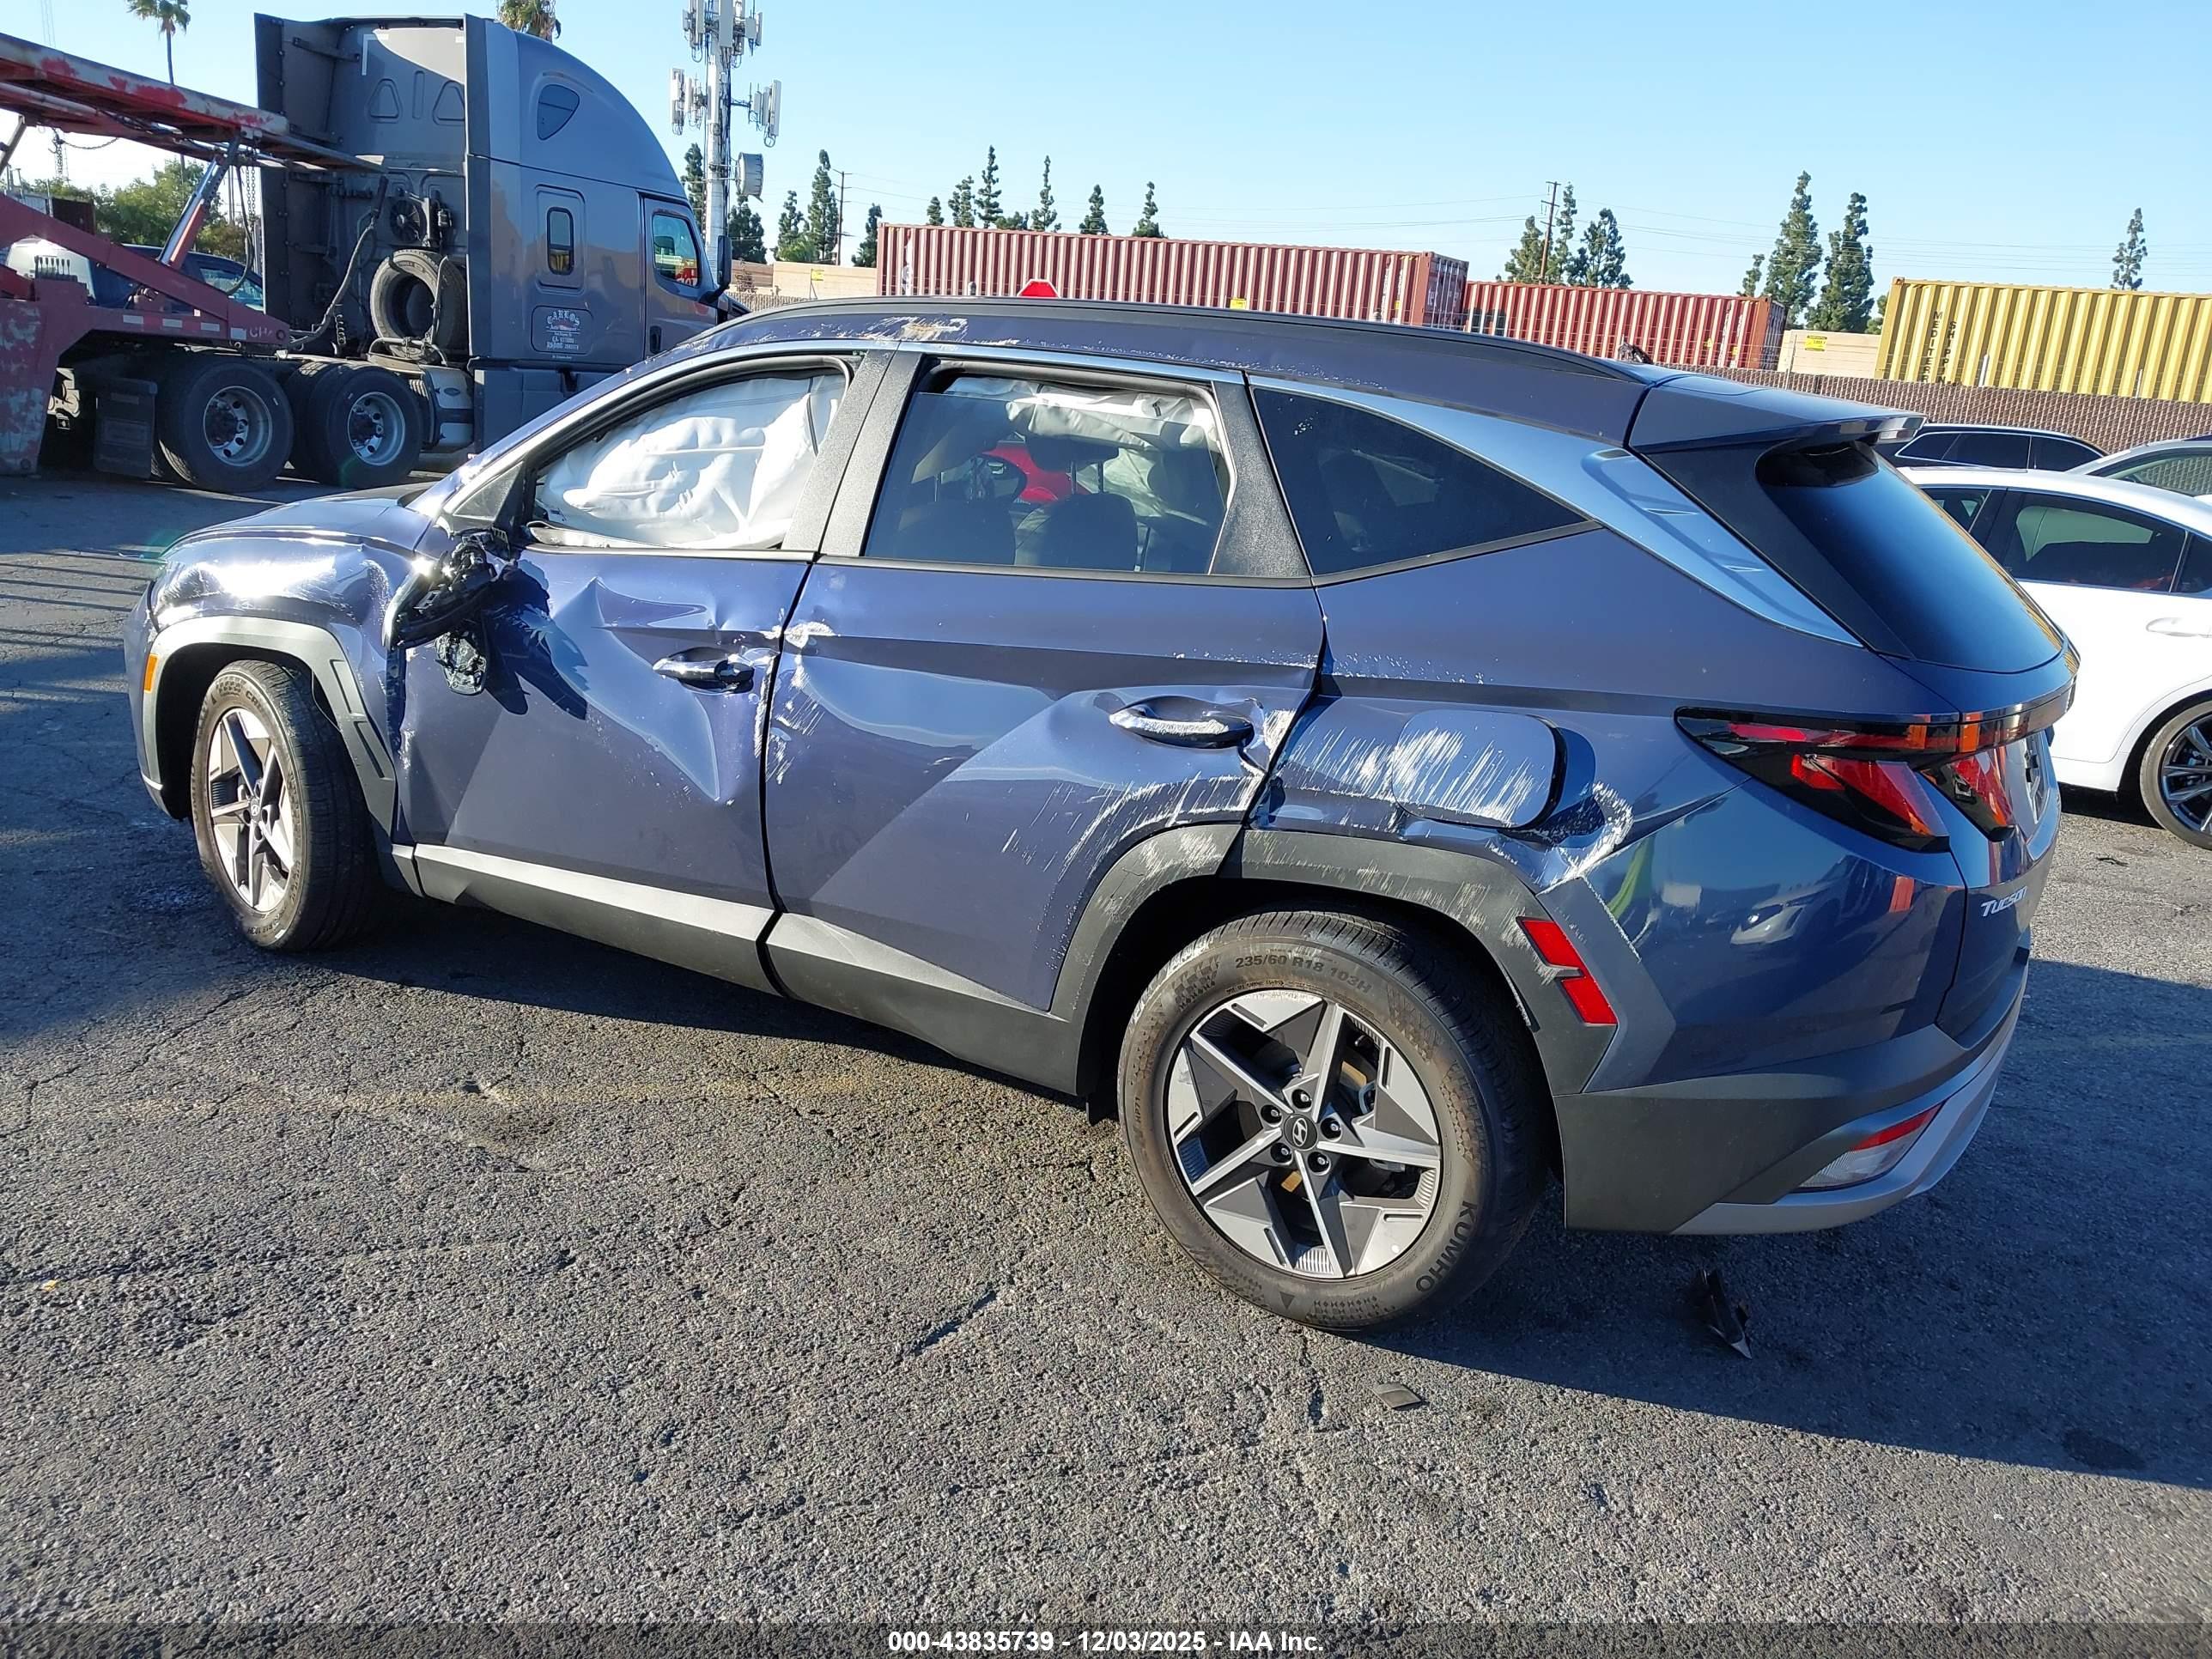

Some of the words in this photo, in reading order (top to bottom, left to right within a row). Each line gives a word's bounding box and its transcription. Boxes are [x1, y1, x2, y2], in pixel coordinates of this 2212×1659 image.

[546, 309, 580, 326] CARLOS
[1980, 885, 2028, 917] TUCSON
[1235, 954, 1288, 969] 235/60
[1291, 956, 1325, 973] R18
[1330, 967, 1373, 994] 103H
[1415, 1200, 1478, 1292] KUMHO
